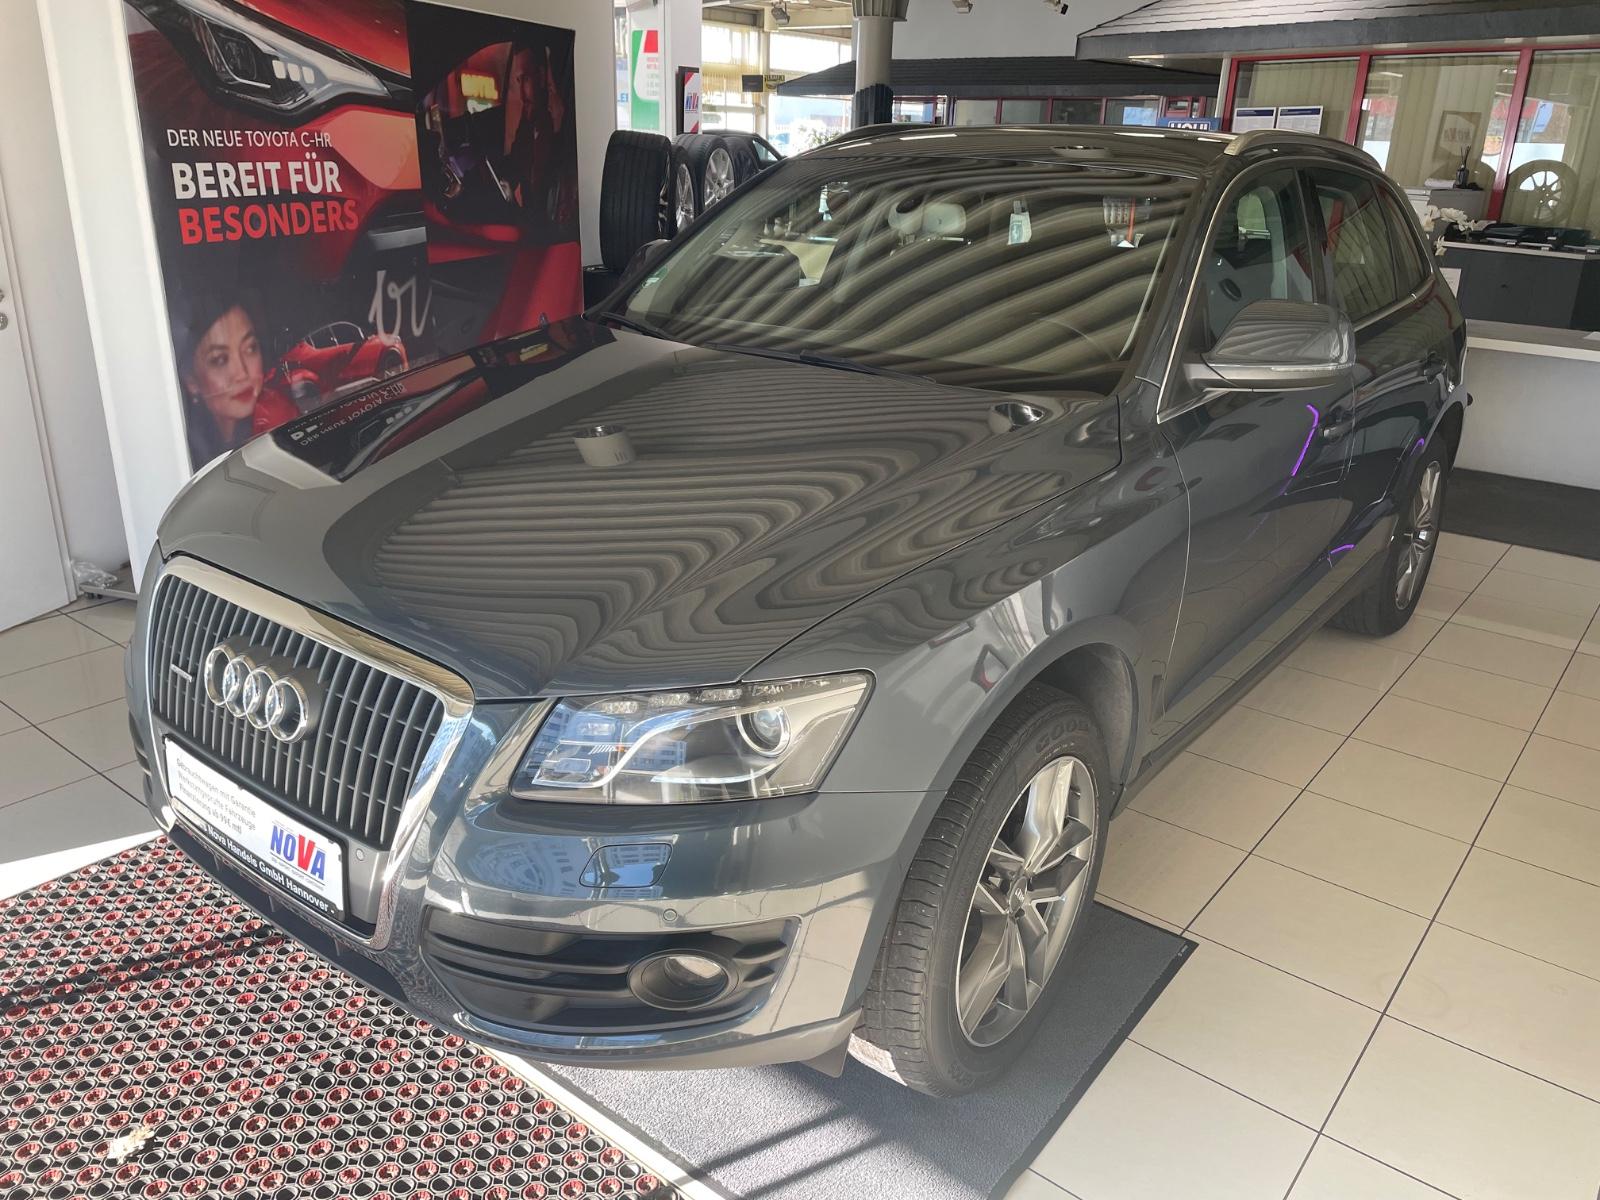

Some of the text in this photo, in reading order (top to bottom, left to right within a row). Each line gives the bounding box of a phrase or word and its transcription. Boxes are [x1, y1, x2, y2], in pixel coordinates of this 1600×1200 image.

[166, 128, 333, 148] DER NEUE TOYOTA C-HR
[171, 151, 343, 200] BEREIT FÜR
[178, 199, 359, 245] BESONDERS
[207, 824, 227, 846] Nova
[225, 837, 259, 869] Handels
[258, 859, 286, 886] GmbH
[285, 876, 330, 913] Hannover
[269, 823, 327, 881] NOVA
